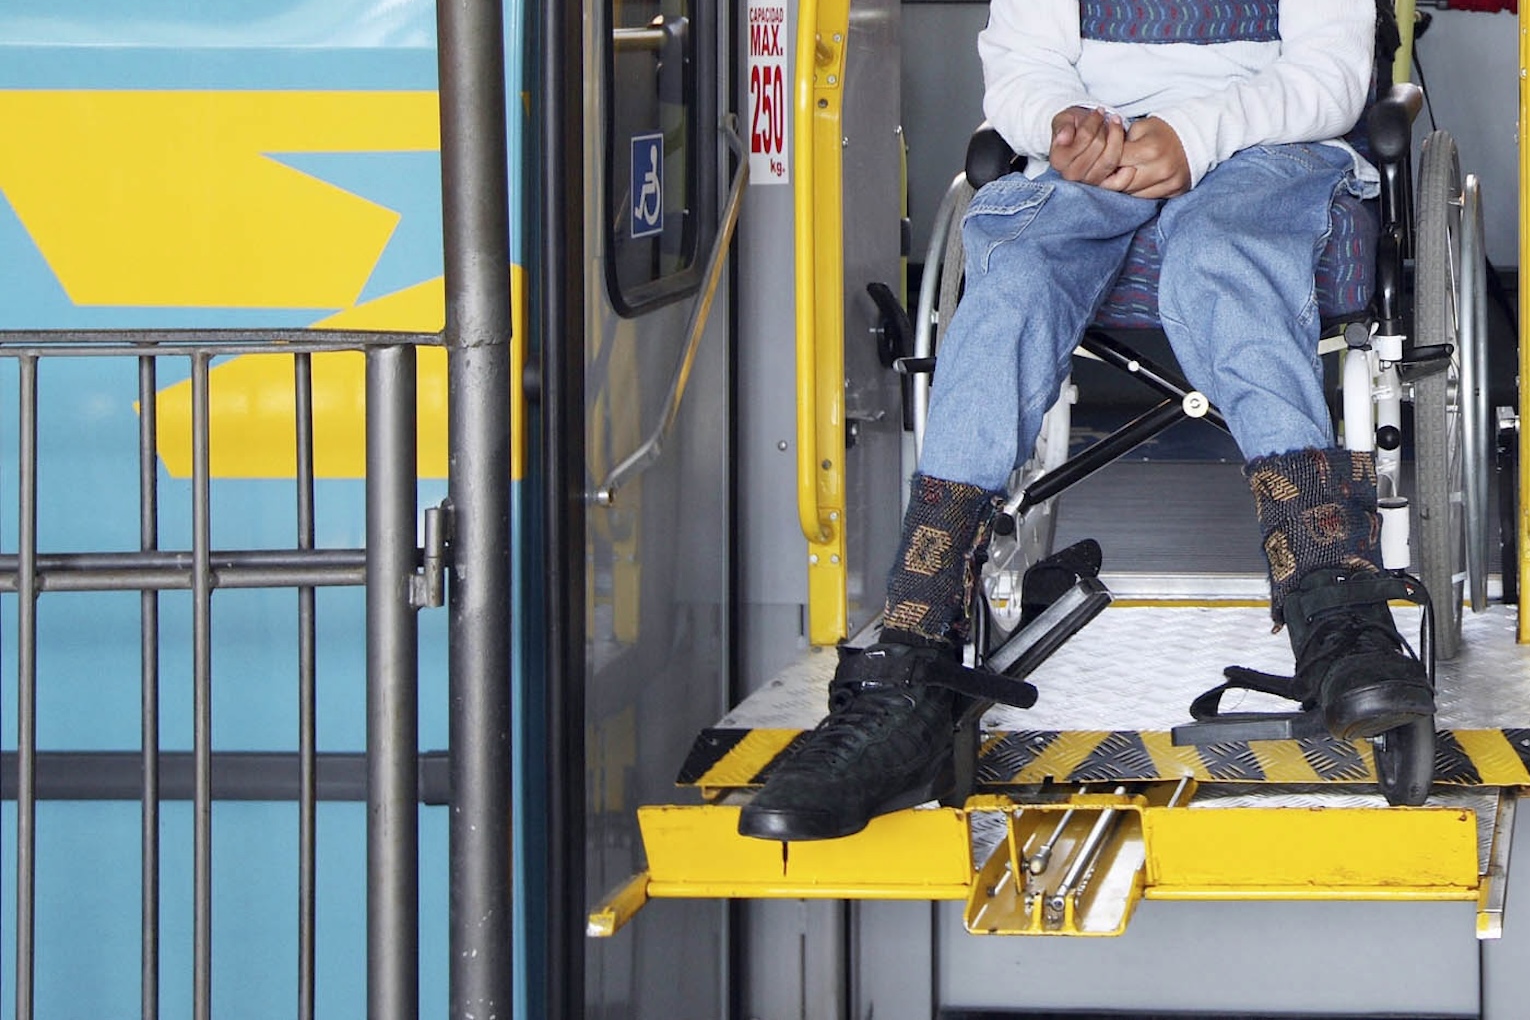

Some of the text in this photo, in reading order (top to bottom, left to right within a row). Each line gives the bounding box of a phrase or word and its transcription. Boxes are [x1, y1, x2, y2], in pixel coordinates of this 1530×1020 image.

[749, 7, 784, 23] CAPACIDAD
[750, 25, 784, 56] MAX.
[751, 65, 784, 154] 250
[770, 158, 786, 177] kg.
